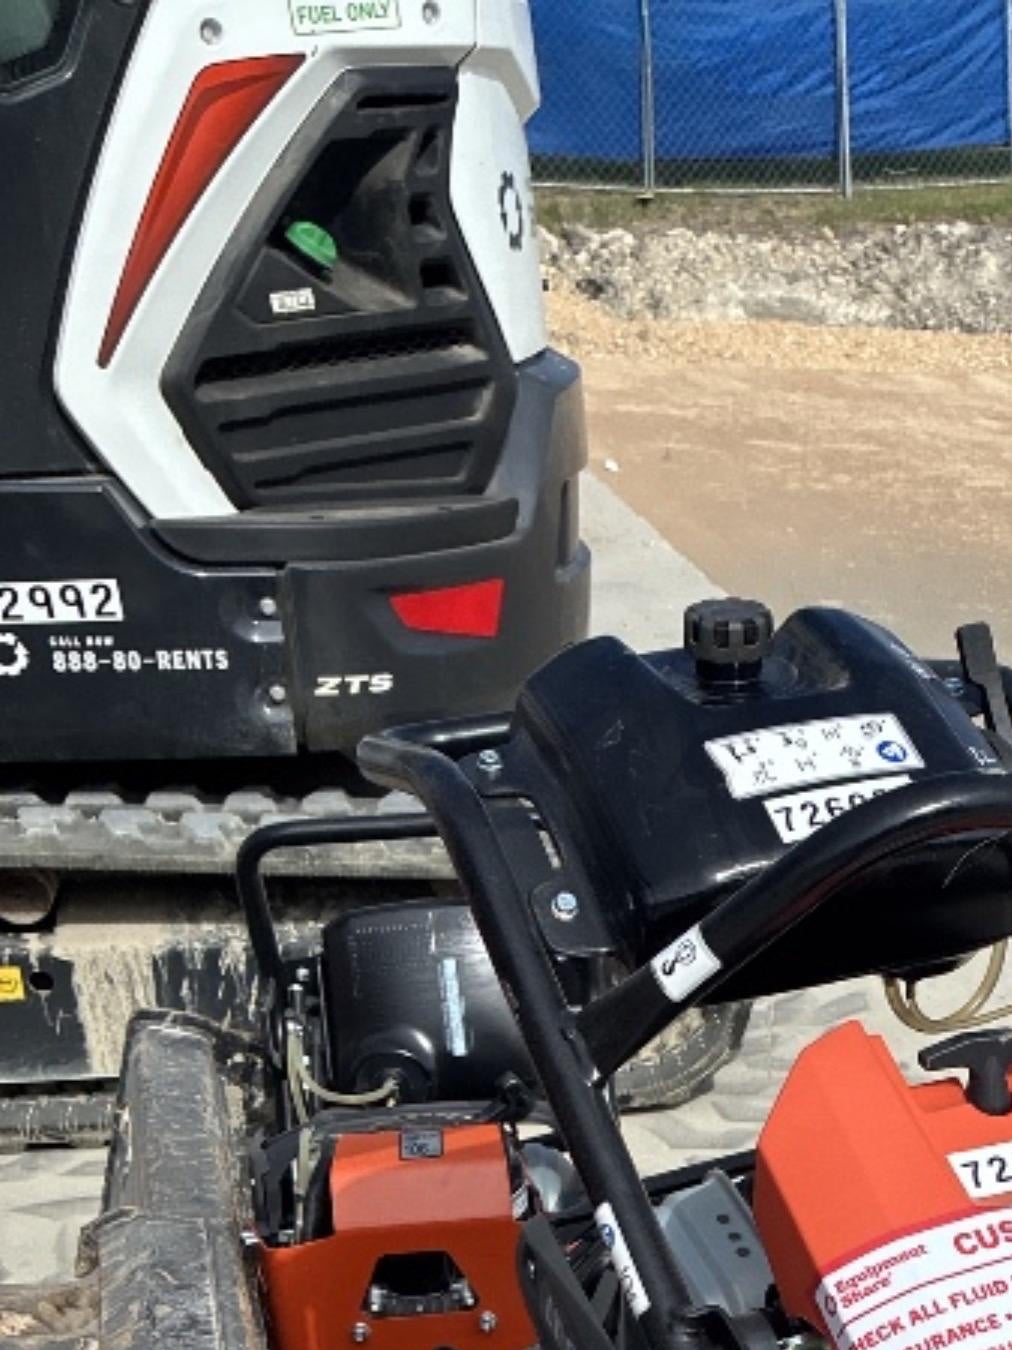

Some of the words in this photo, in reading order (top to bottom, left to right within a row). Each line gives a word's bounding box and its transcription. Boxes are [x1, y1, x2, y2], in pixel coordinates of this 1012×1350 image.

[296, 5, 342, 25] FUEL
[347, 0, 389, 21] ONLY
[0, 584, 117, 620] 2992
[52, 649, 229, 673] 888-80-RENTS
[313, 673, 394, 697] ZTS
[833, 1244, 929, 1295] Equipment
[908, 1299, 948, 1327] ALL
[948, 1279, 1009, 1309] FLUID
